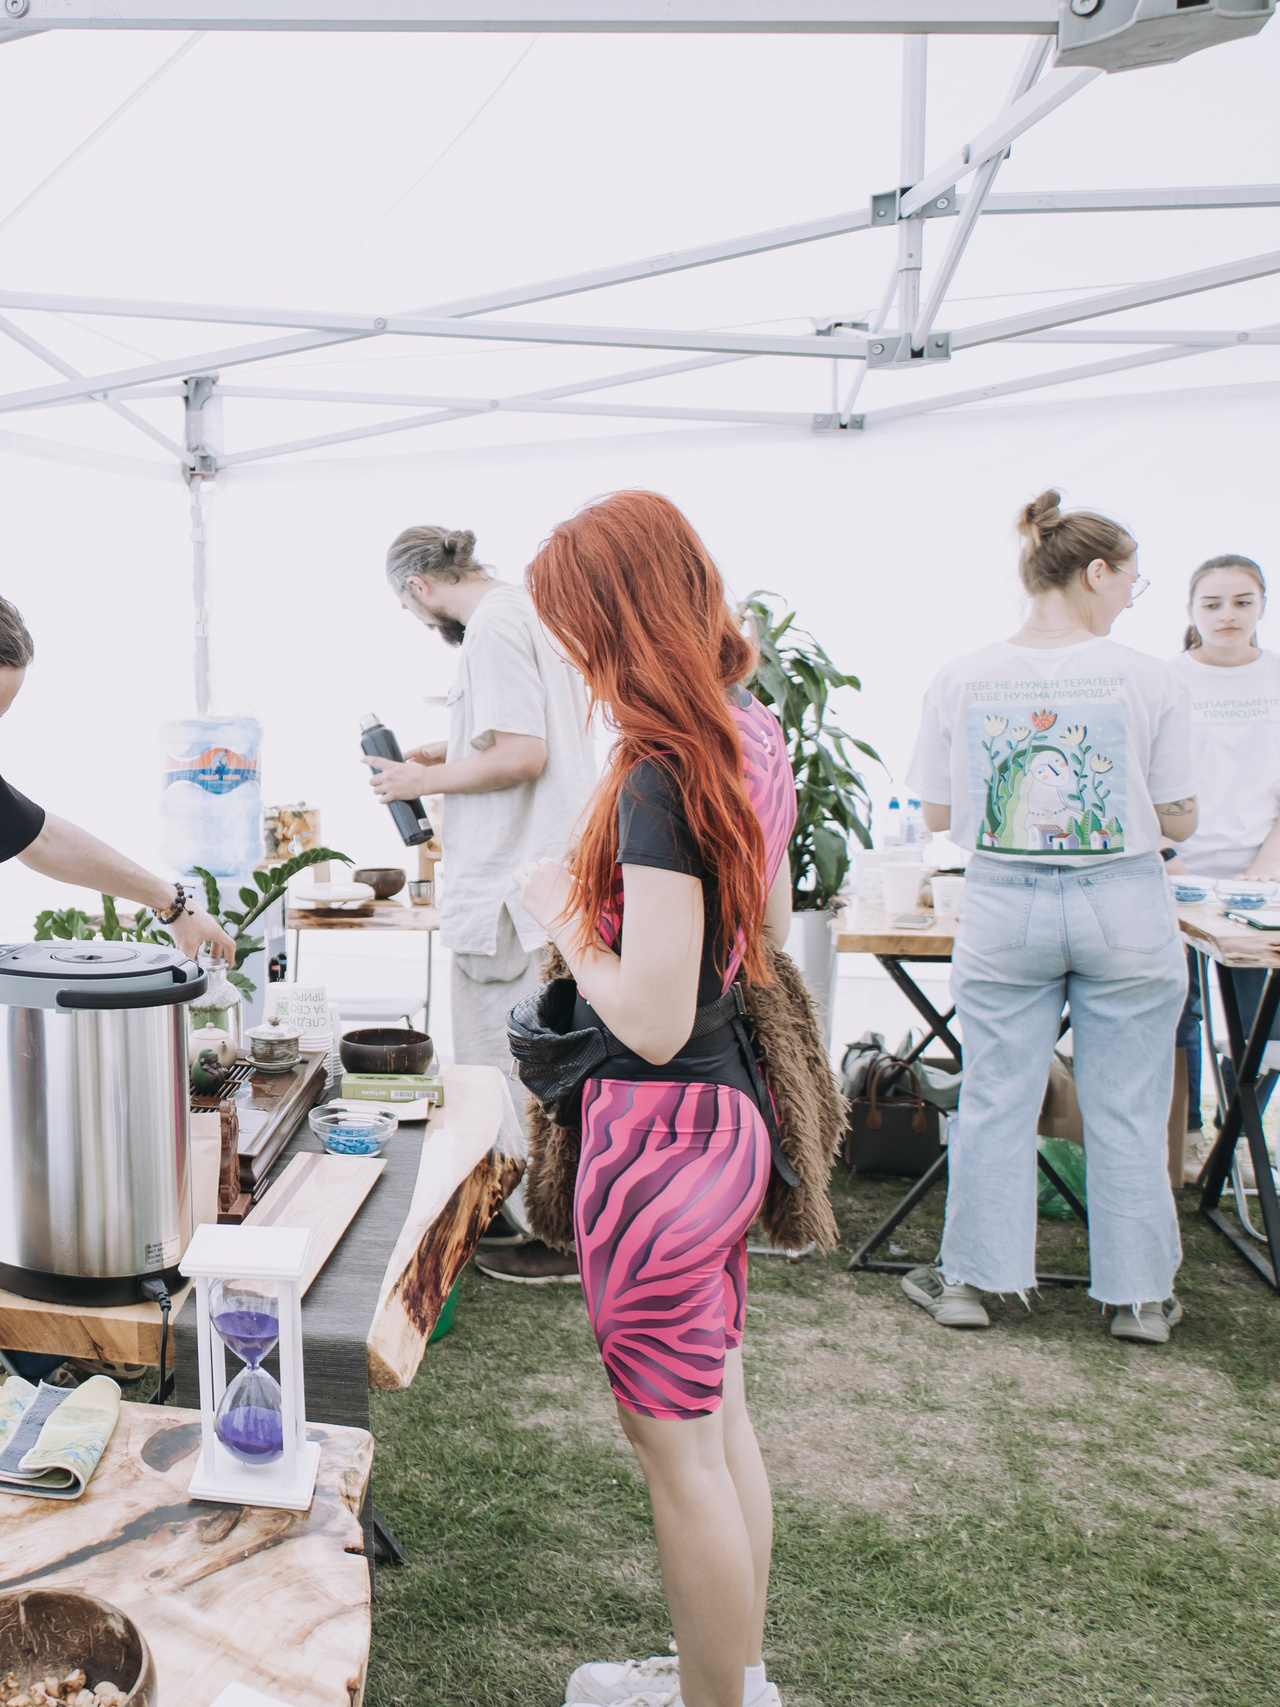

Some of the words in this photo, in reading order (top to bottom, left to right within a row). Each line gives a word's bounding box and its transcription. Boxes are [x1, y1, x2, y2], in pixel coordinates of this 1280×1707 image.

[965, 681, 992, 691] ТЕБЕ
[995, 680, 1011, 690] НЕ
[1014, 679, 1059, 689] НУЖЕН
[1062, 677, 1126, 688] ТЕРАПЕВТ
[974, 692, 1000, 702] ТЕБЕ
[1004, 691, 1051, 701] НУЖНА
[1204, 708, 1269, 718] ПРИРОДЫ
[291, 992, 324, 1001] ПРИРО
[313, 1004, 325, 1014] ЗА
